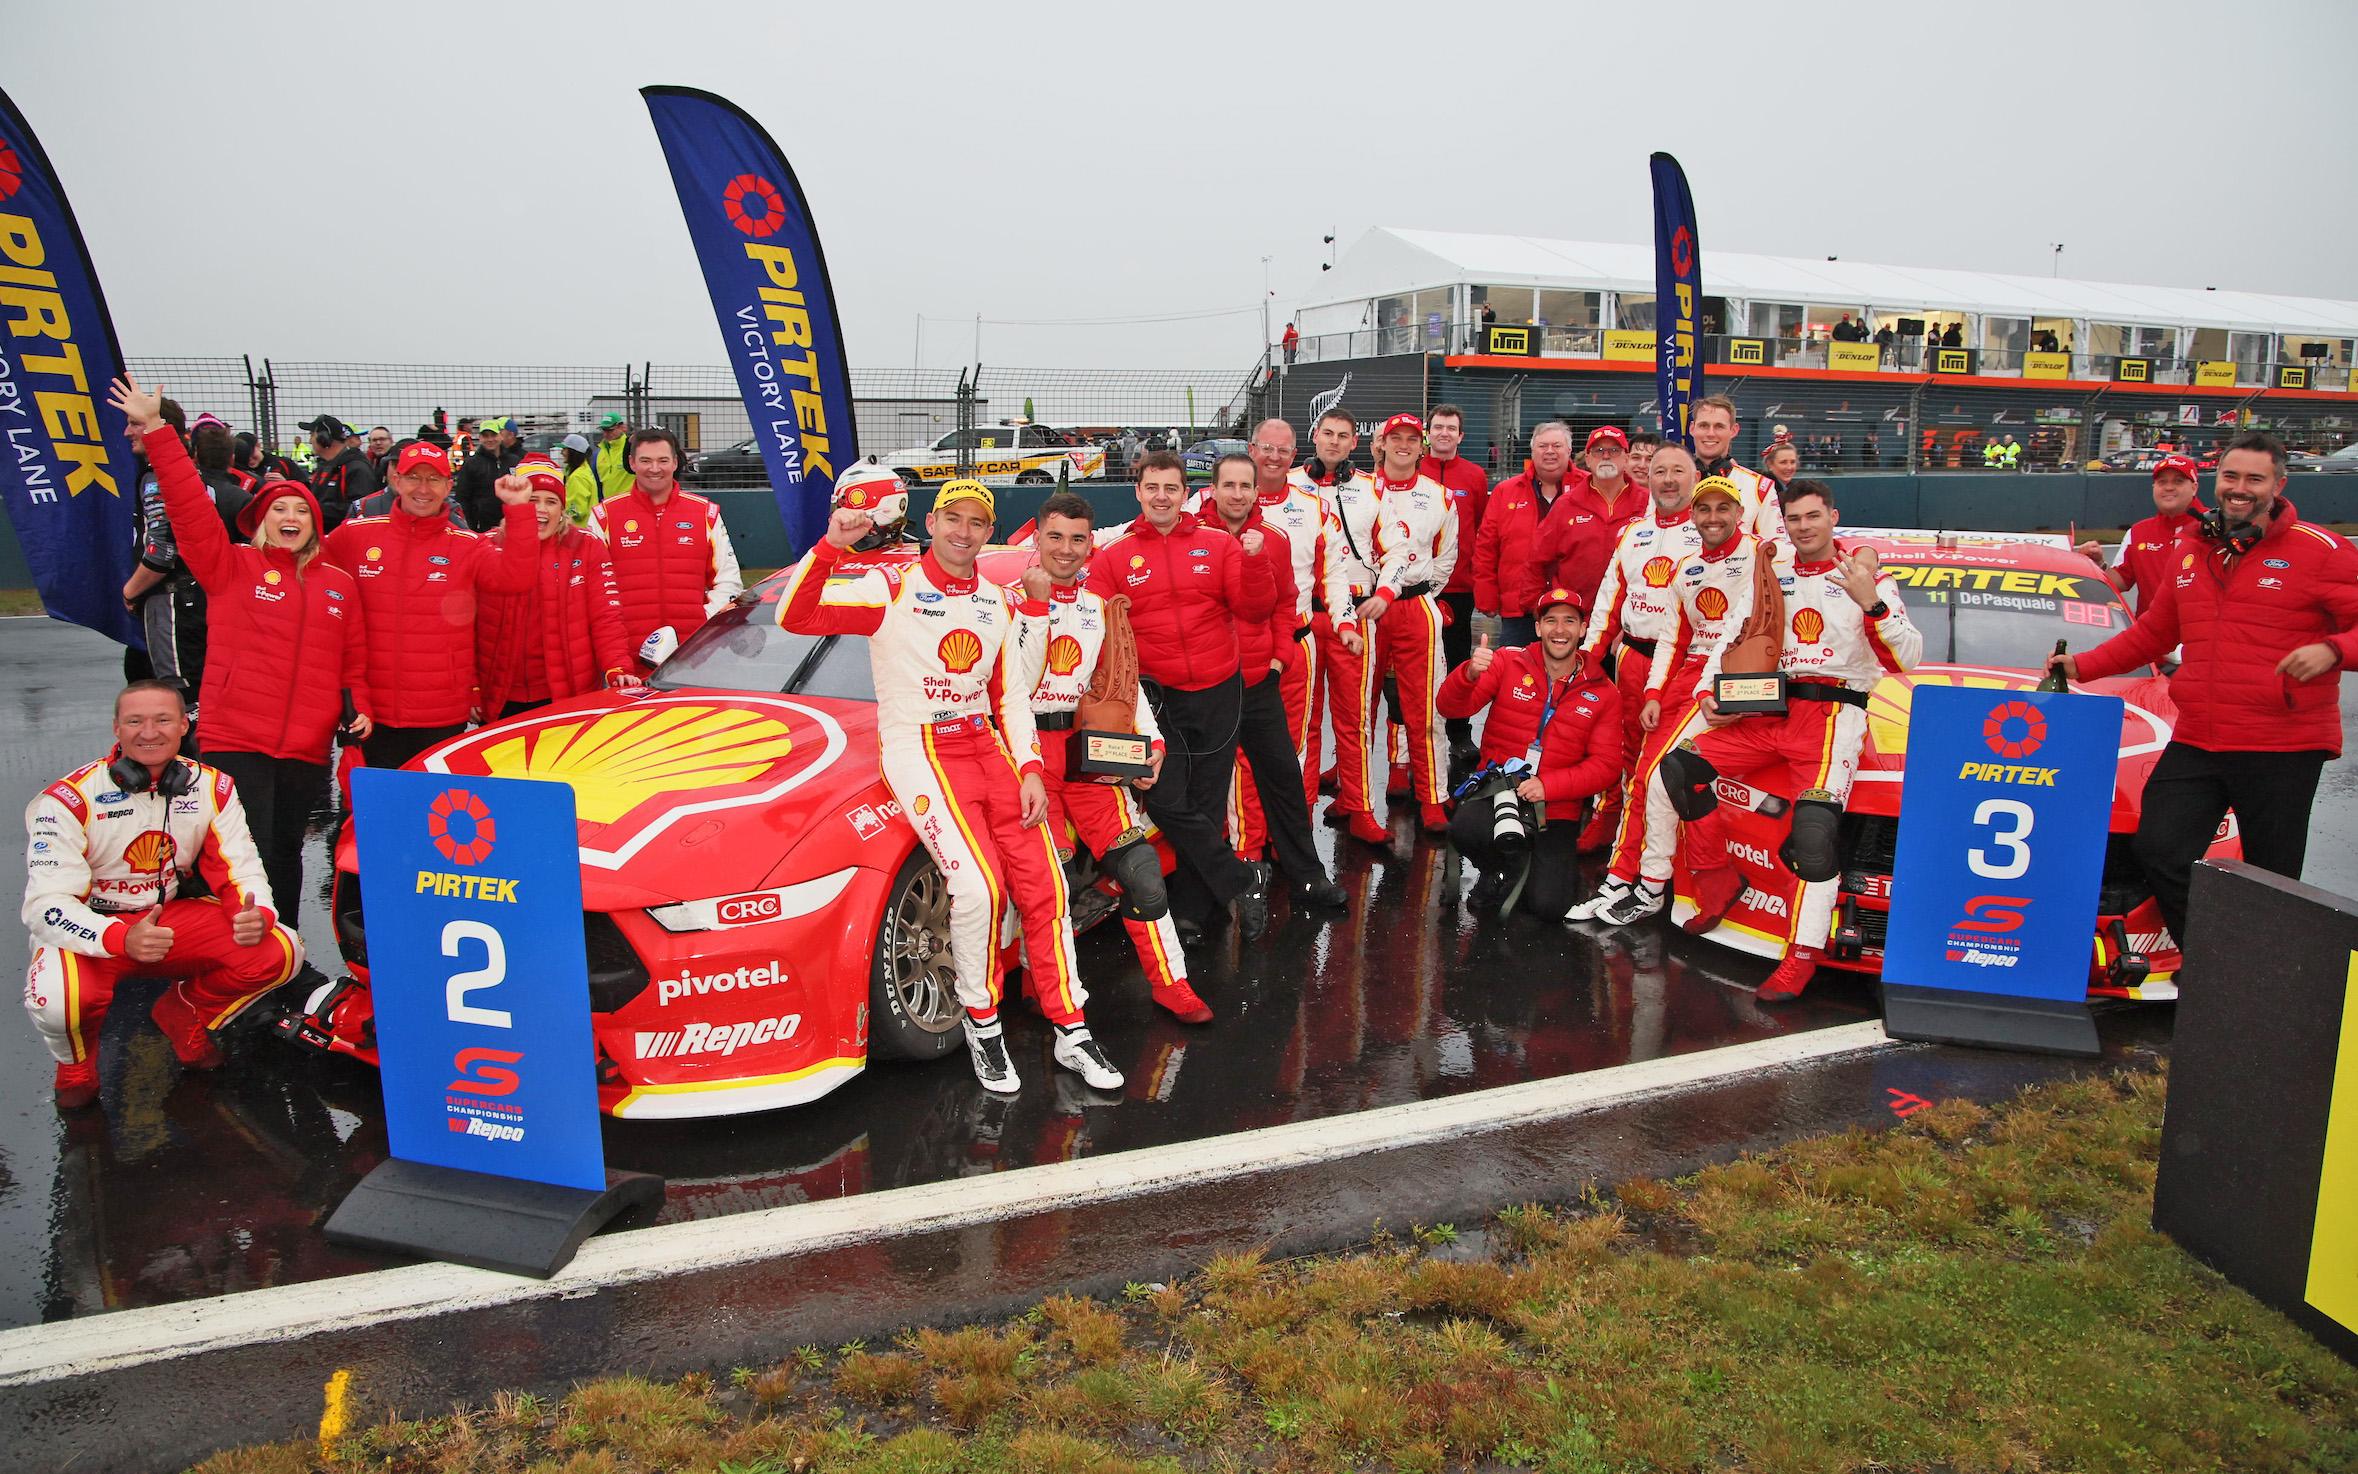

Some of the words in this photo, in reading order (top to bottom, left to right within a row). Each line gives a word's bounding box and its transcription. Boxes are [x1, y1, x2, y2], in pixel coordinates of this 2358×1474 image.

[0, 213, 120, 498] PIRTEK
[1615, 342, 1657, 351] DUNLOP
[1838, 352, 1875, 361] DUNLOP
[744, 242, 834, 482] PIRTEK
[1664, 334, 1675, 421] VICTORY
[736, 305, 784, 412] VICTORY
[771, 419, 803, 485] LANE
[7, 427, 58, 505] LANE
[922, 464, 984, 478] SAFY
[987, 461, 1021, 474] CAR
[1186, 458, 1205, 469] SAFETY
[945, 484, 992, 505] DUNLOP
[1879, 552, 1926, 560] Shell
[1930, 551, 2019, 565] V-Power
[1880, 565, 2083, 599] PIRTEK
[1630, 592, 1647, 600] Shell
[1926, 590, 1947, 604] 11
[1960, 591, 1982, 605] De
[1983, 592, 2056, 611] Pasquale
[921, 608, 946, 618] Repco
[1631, 600, 1665, 614] V-Pow
[1780, 656, 1826, 669] V-Pwer
[923, 676, 951, 687] Shell
[1038, 680, 1051, 690] ell
[924, 688, 984, 704] V-Power
[936, 722, 962, 735] imar
[1958, 761, 2061, 787] PIRTEK
[1717, 782, 1749, 803] CRC
[107, 808, 134, 819] Repco
[929, 815, 944, 836] Shell
[924, 820, 951, 870] V-Power
[1967, 798, 2035, 880] 3
[1725, 838, 1775, 870] votel.
[415, 870, 520, 904] PIRTEK
[720, 897, 778, 921] CRC
[1740, 886, 1787, 918] epc
[1946, 940, 2020, 952] CHAMPIONSHIP
[1947, 932, 2021, 946] SUPERCARS
[883, 906, 902, 1016] DUNLOP
[1961, 948, 2019, 968] Repco
[440, 920, 513, 1029] 2
[658, 960, 789, 1007] pivotel.
[674, 1013, 801, 1057] Repco
[445, 1095, 523, 1115] SUPERCARS
[446, 1105, 524, 1122] CHAMPIONSHIP
[465, 1117, 525, 1142] Repco
